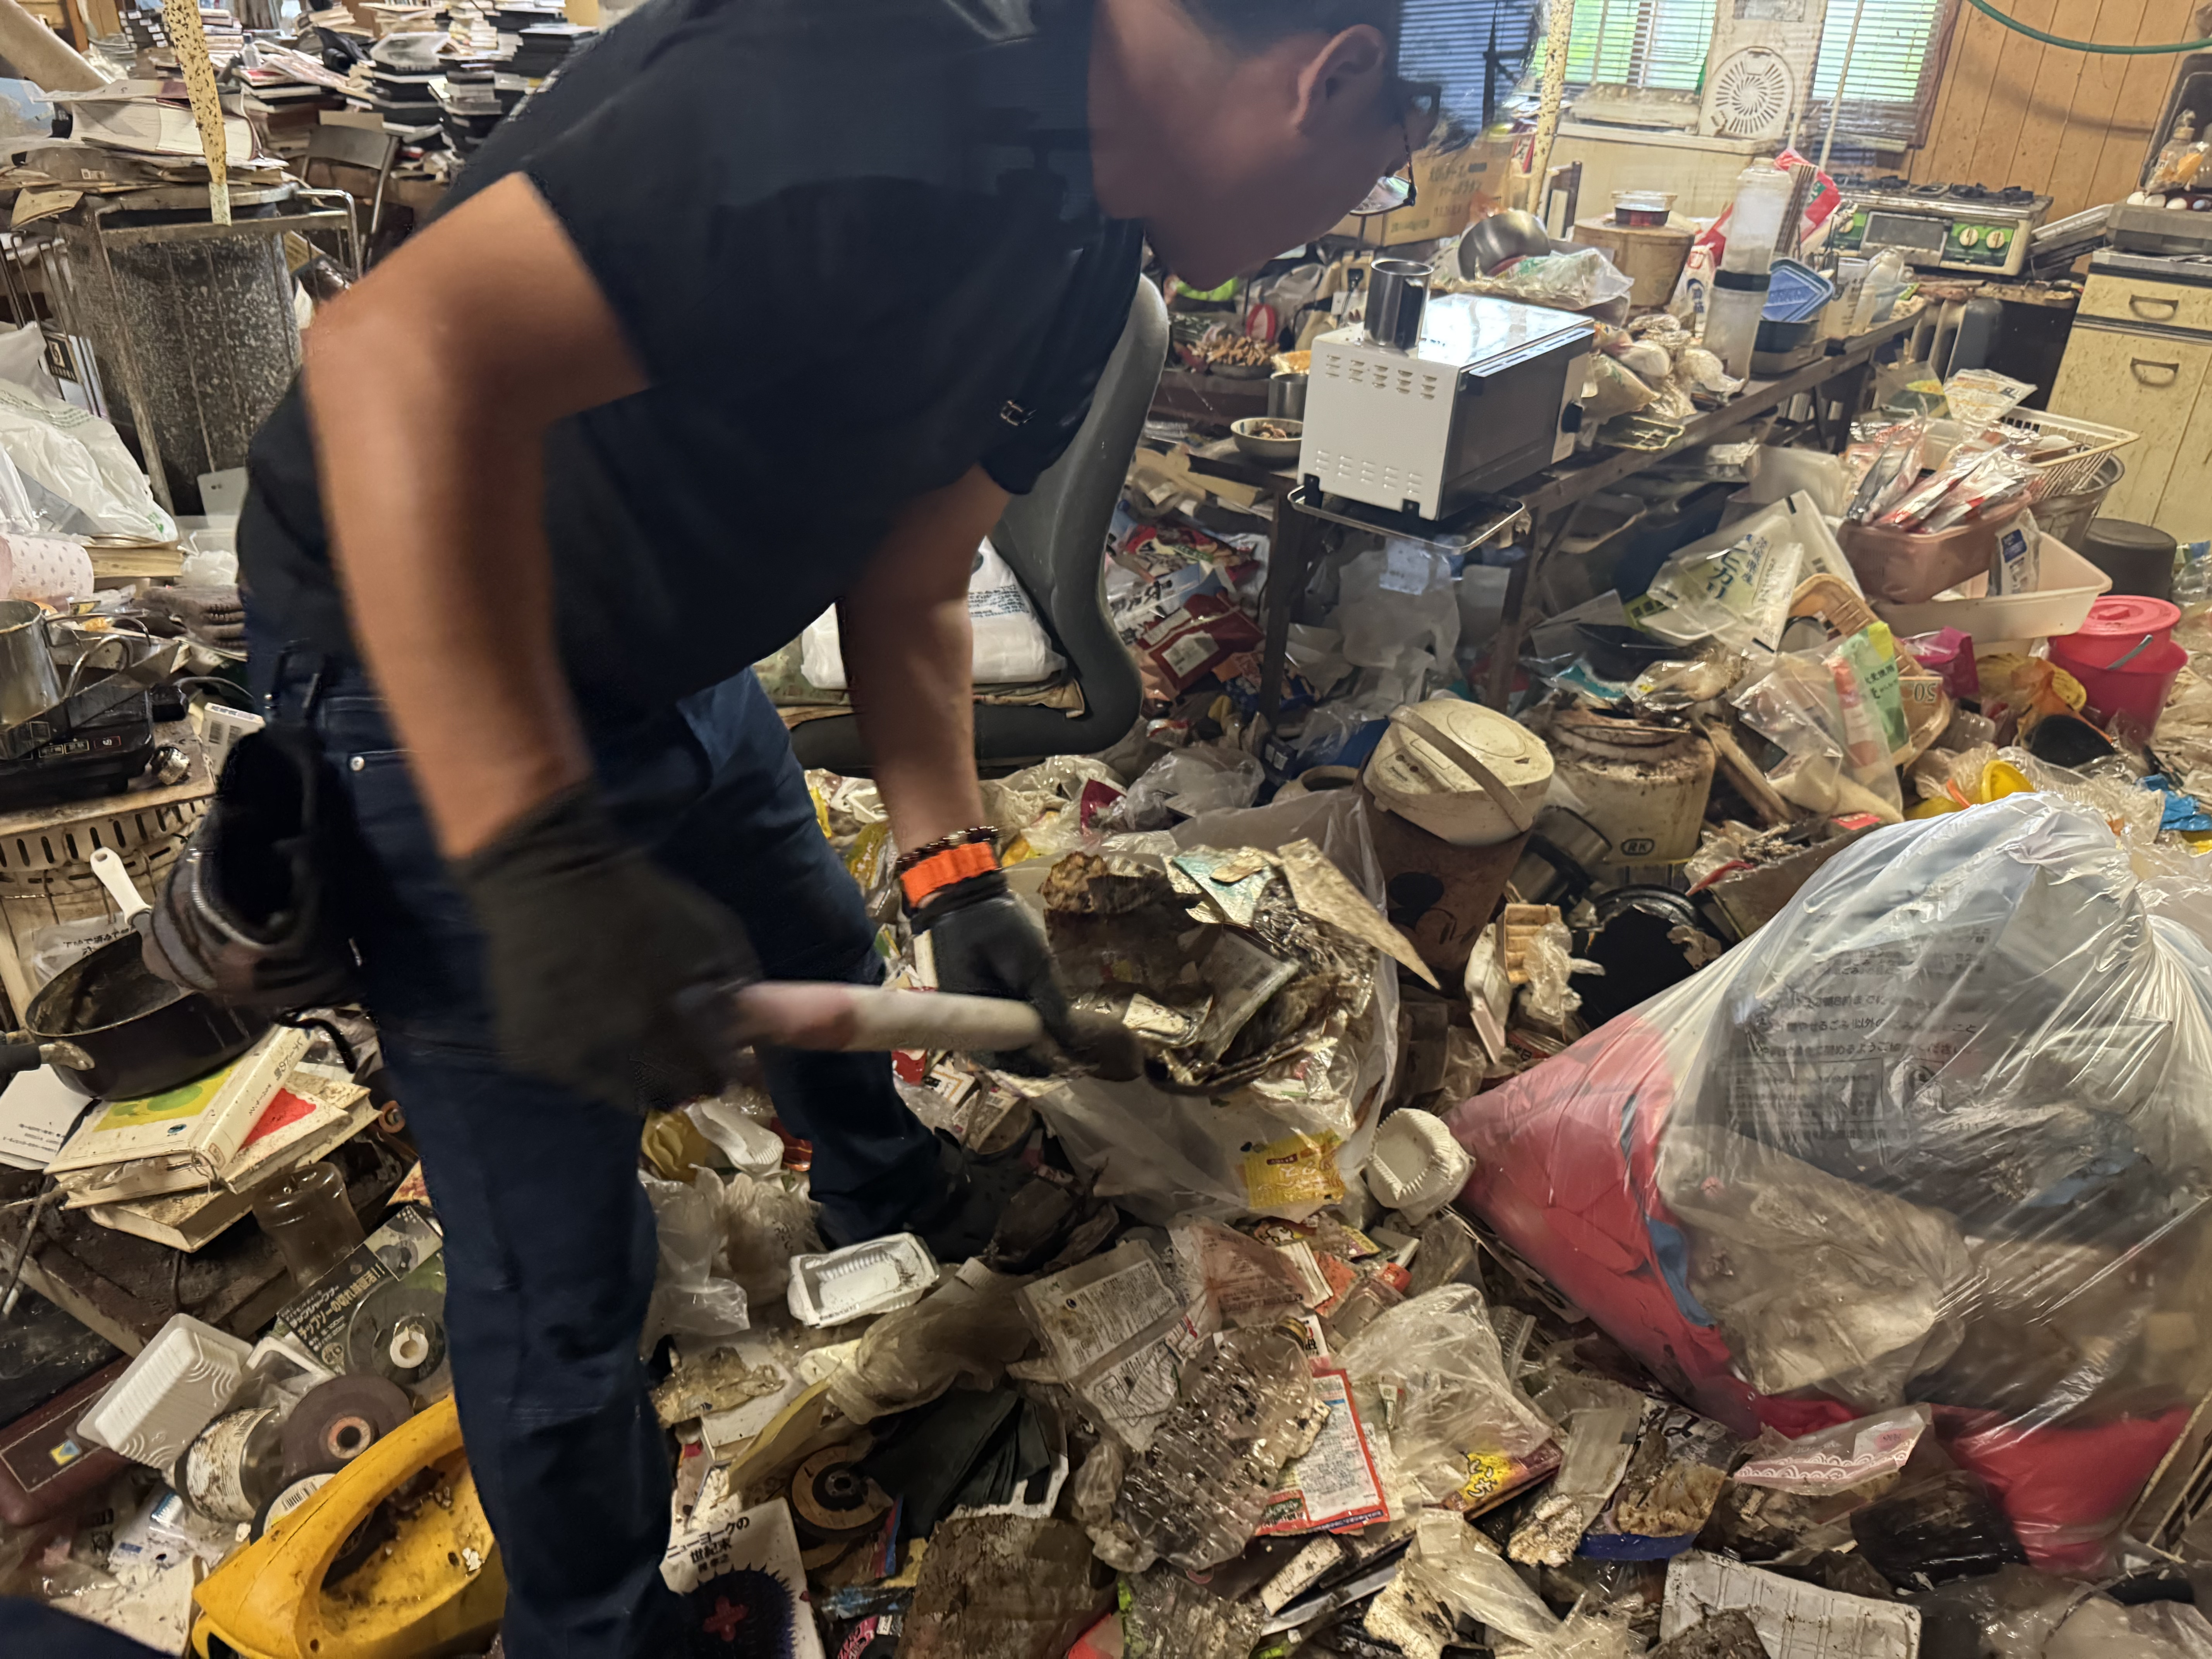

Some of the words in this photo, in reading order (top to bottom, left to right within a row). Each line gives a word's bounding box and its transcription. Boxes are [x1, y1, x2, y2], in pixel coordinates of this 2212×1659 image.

[666, 1516, 750, 1558] ニューヨークの
